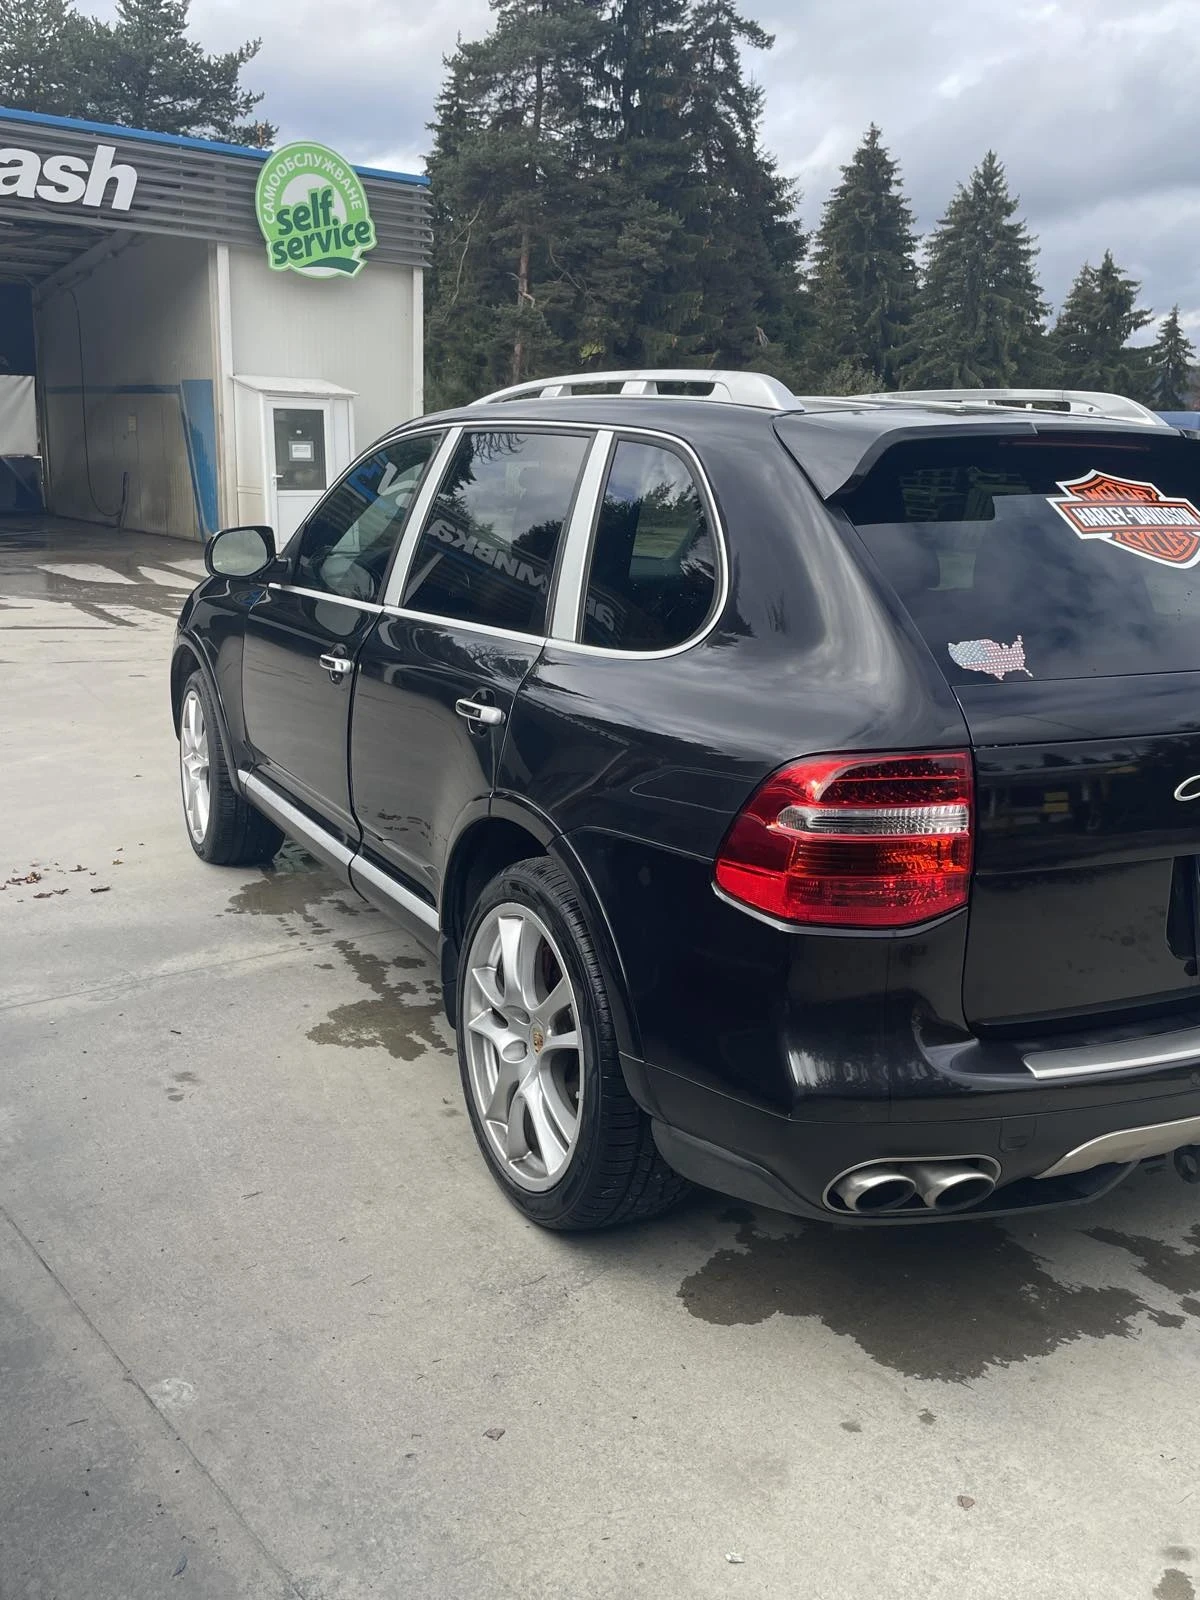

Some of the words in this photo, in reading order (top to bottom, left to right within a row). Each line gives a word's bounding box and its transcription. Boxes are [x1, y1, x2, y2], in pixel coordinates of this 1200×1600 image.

[263, 151, 363, 225] САМООБСЛУЖВАНЕ
[276, 188, 334, 236] self
[272, 219, 371, 265] service
[1083, 480, 1151, 501] MOTOR
[1071, 506, 1200, 527] HARLEY-DAVIDSON
[1122, 531, 1192, 556] CYCLES
